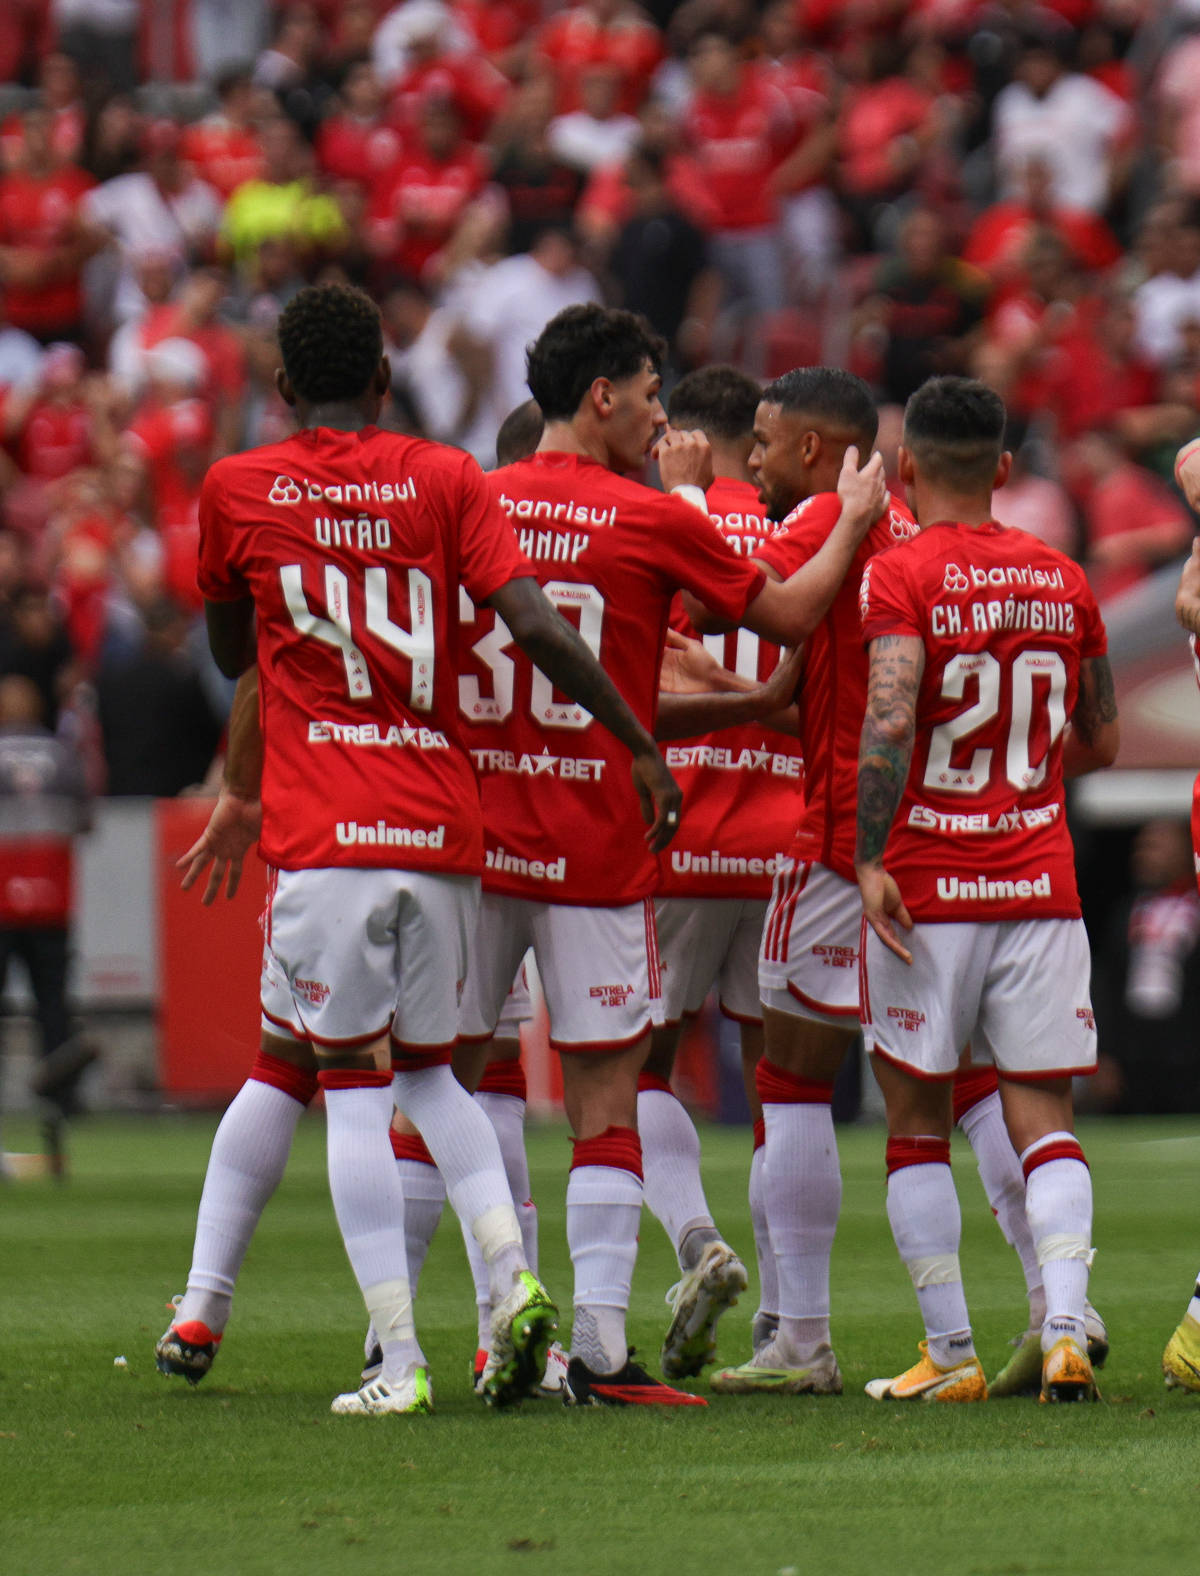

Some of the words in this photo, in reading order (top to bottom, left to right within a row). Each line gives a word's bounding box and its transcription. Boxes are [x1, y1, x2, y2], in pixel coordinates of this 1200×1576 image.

[303, 476, 417, 503] banrisul
[499, 493, 617, 527] banrisul
[970, 563, 1065, 589] banrisul
[932, 604, 970, 636] CH.
[280, 564, 436, 712] 44
[458, 580, 604, 730] 30
[308, 721, 404, 748] ESTRELA
[924, 650, 1068, 793] 20
[559, 757, 606, 781] BET
[665, 745, 752, 770] ESTRELA
[771, 753, 806, 778] BE
[907, 804, 1008, 833] ESTRELA
[1021, 803, 1060, 829] BET
[336, 820, 446, 849] Unimed
[671, 850, 785, 875] Unimed
[937, 872, 1052, 900] Unimed
[832, 957, 856, 968] BET
[589, 984, 634, 998] ESTRELA
[608, 996, 627, 1007] BET
[887, 1007, 926, 1023] ESTRELA
[904, 1021, 920, 1032] BET
